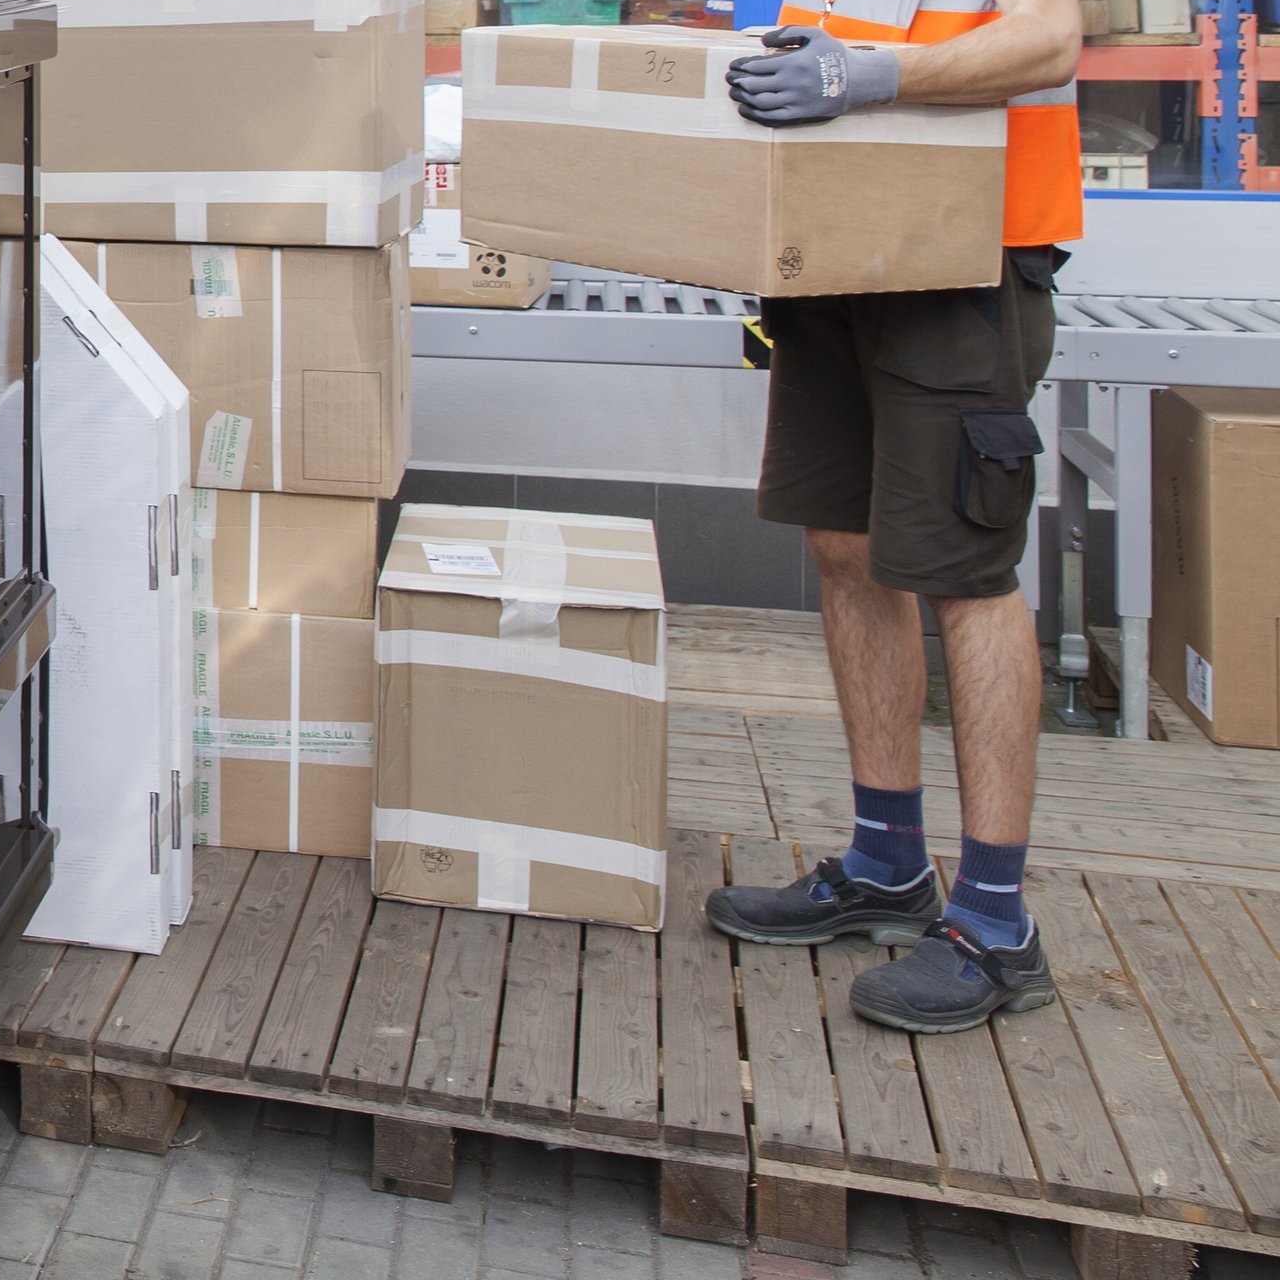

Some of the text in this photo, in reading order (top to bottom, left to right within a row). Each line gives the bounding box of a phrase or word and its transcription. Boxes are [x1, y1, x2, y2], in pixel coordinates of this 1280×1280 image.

[644, 49, 677, 83] 3/3
[472, 279, 512, 289] wacom
[198, 652, 208, 697] FRAGILE
[286, 729, 354, 740] Aasic.S.L.U.
